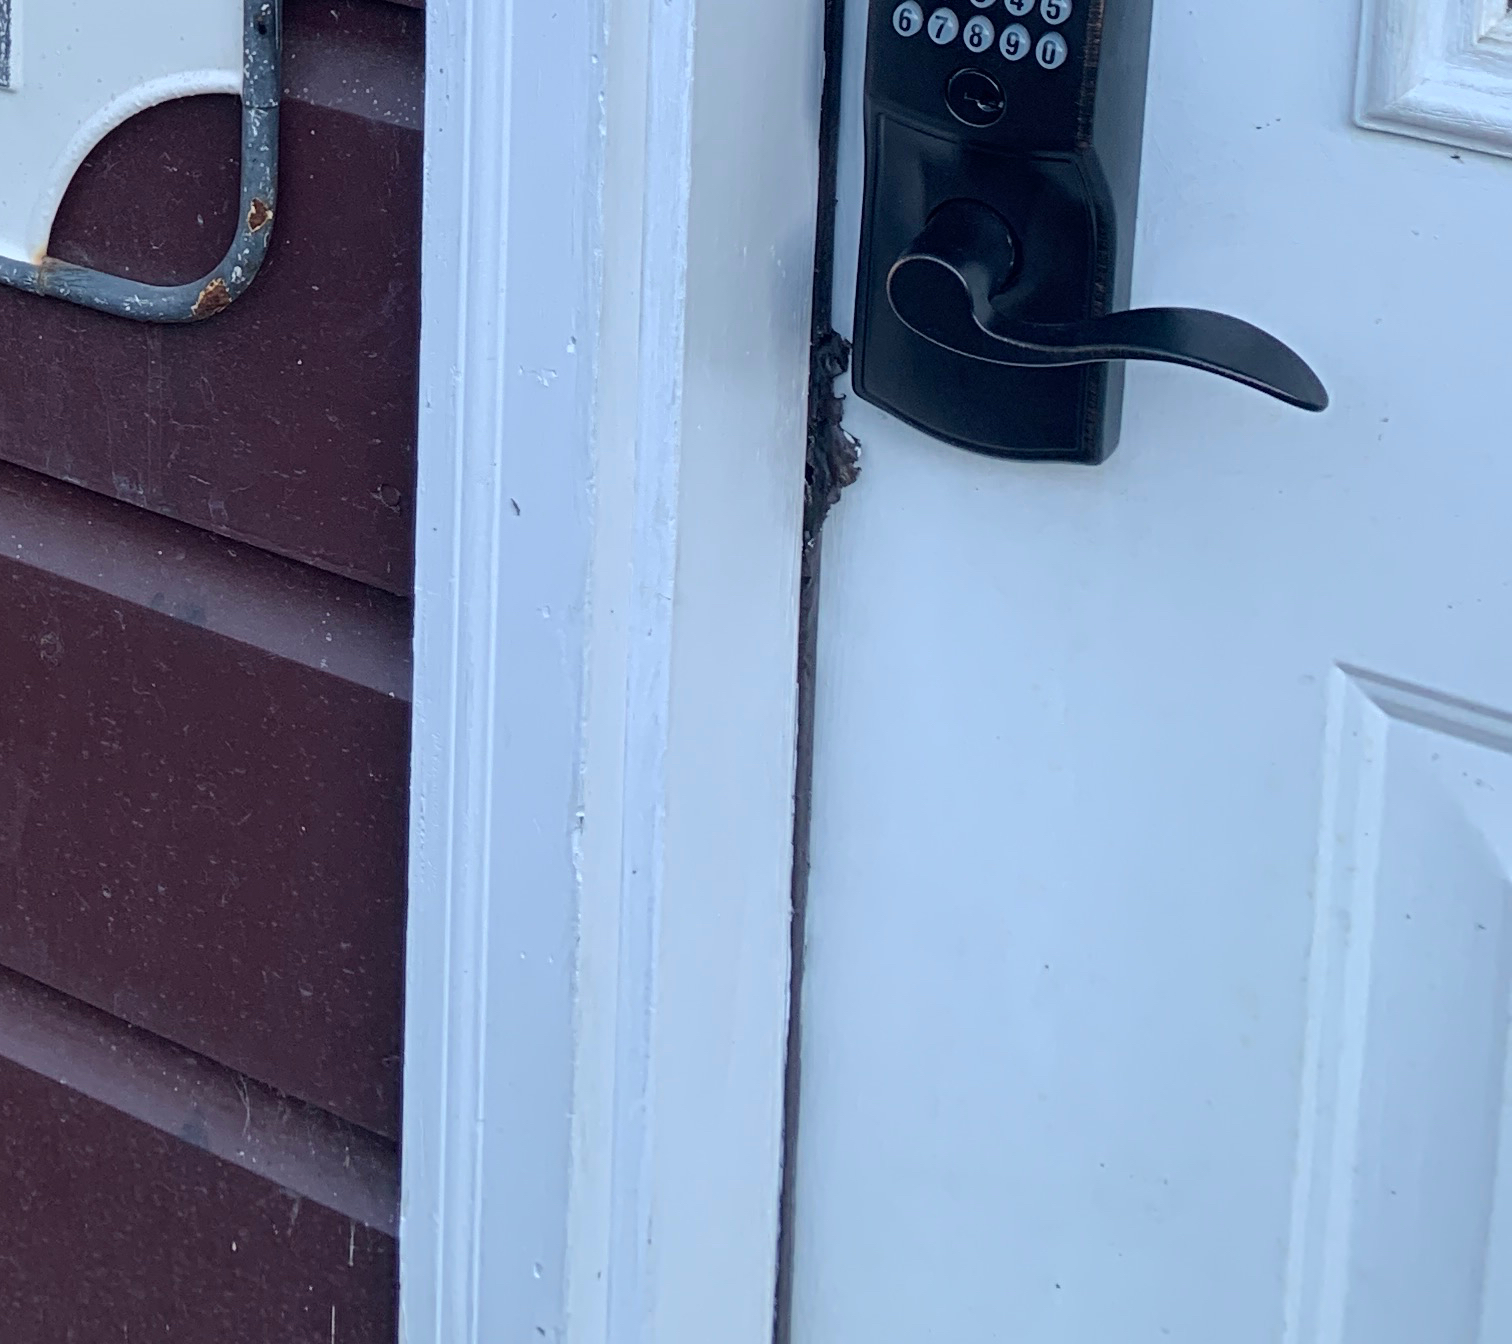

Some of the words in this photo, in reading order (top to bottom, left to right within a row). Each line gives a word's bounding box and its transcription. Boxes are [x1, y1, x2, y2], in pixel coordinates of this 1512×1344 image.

[898, 8, 911, 32] 6
[934, 15, 948, 39] 7
[969, 23, 983, 48] 8
[1005, 32, 1019, 56] 9
[1041, 40, 1056, 65] 0
